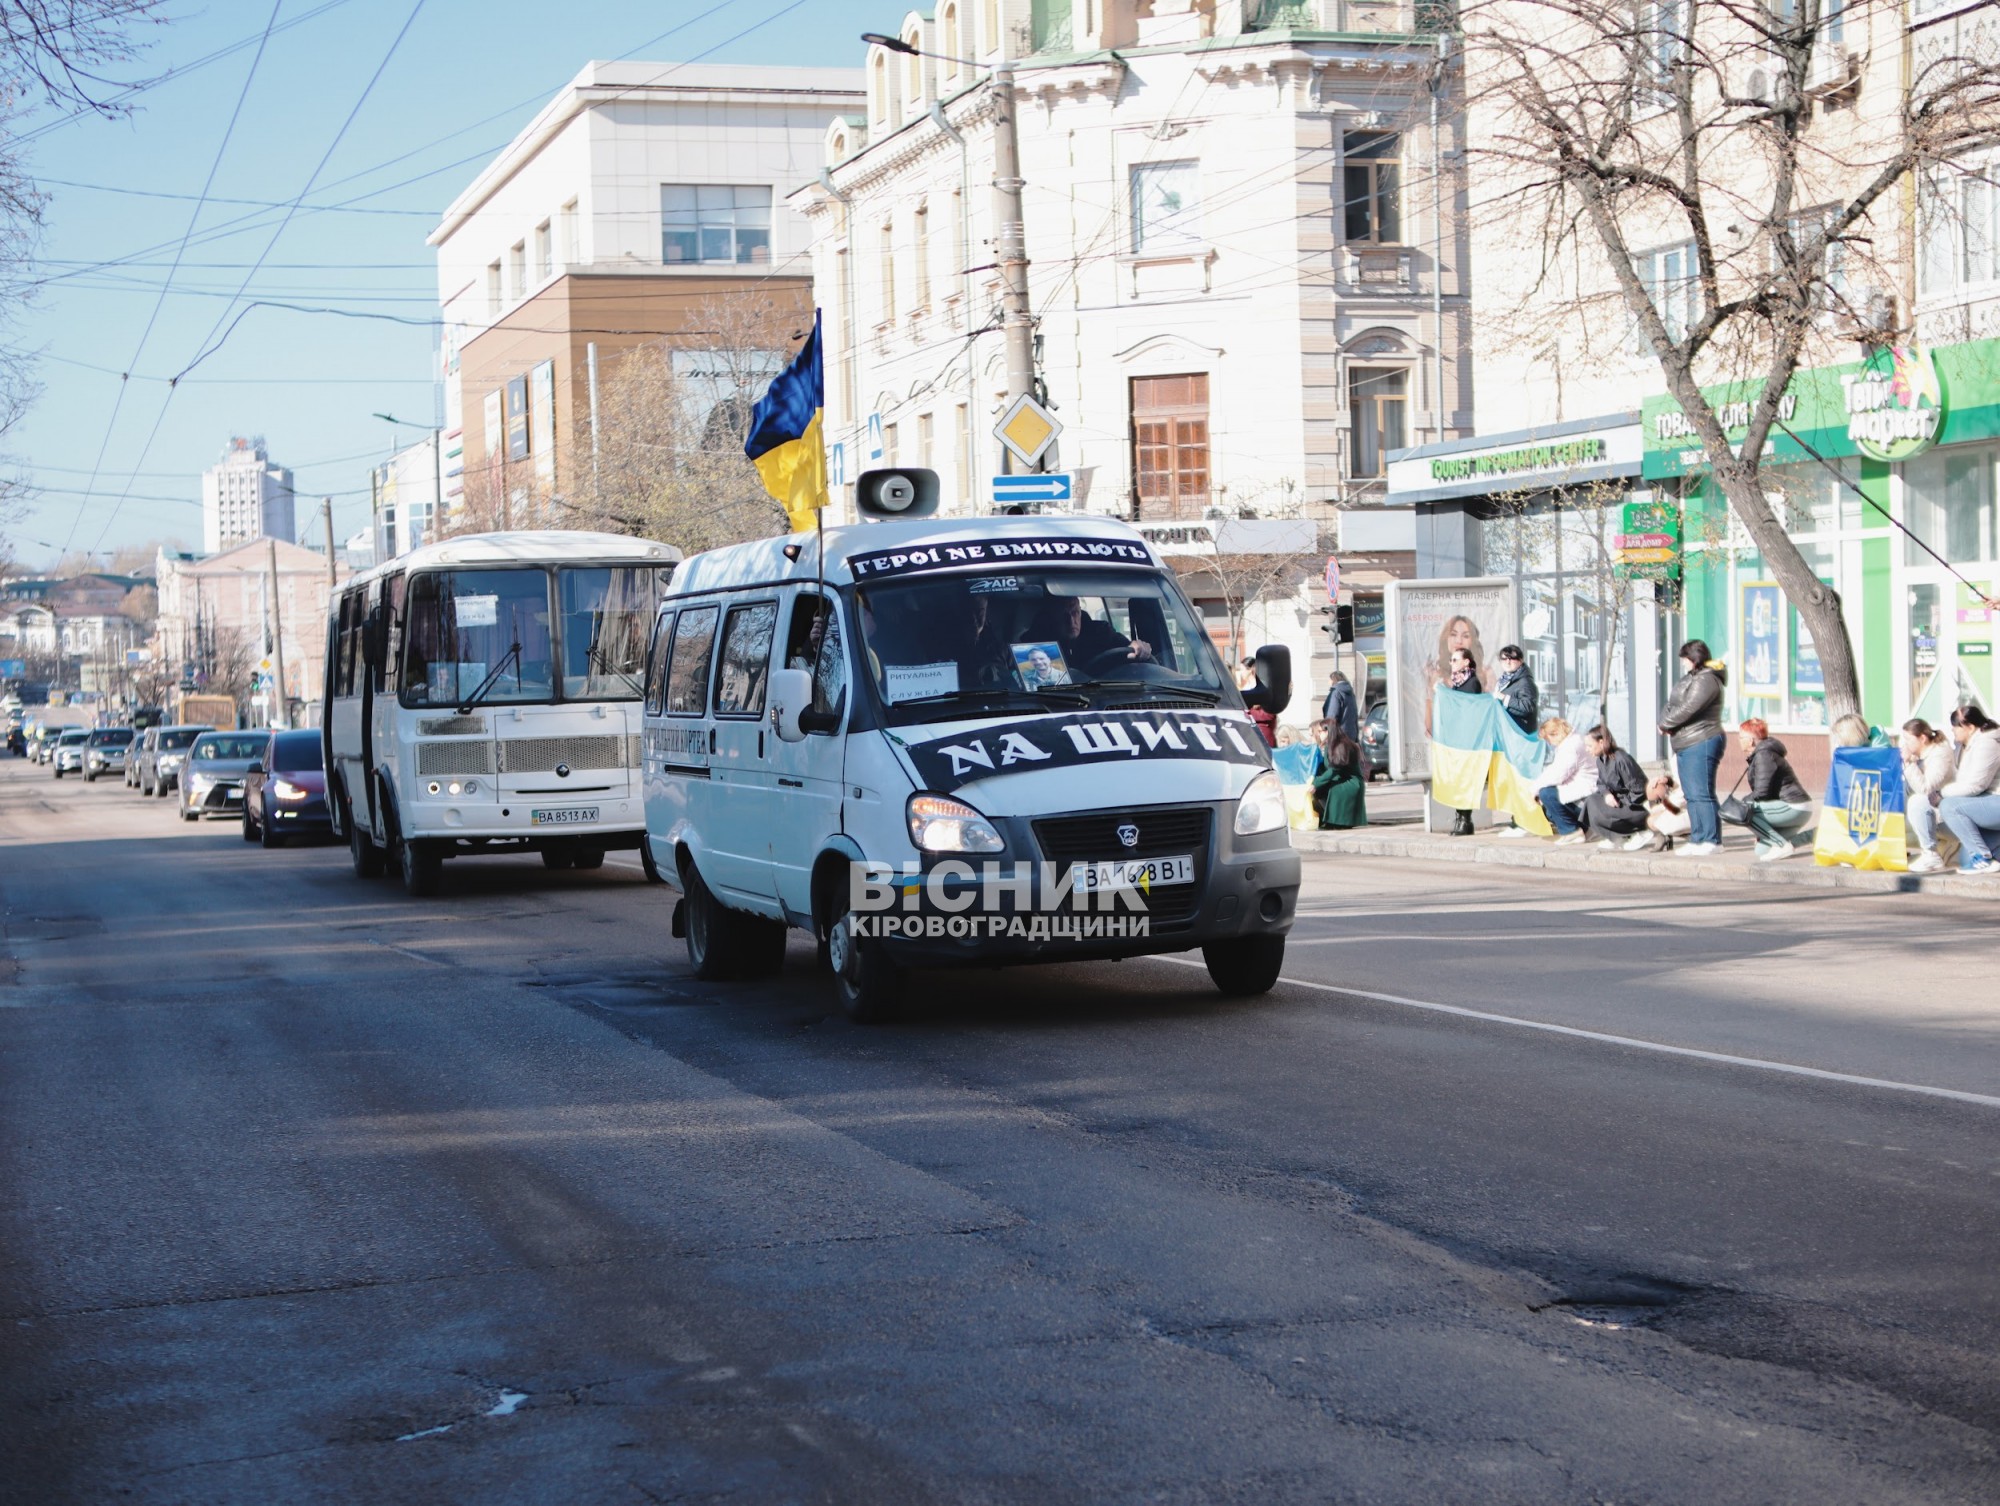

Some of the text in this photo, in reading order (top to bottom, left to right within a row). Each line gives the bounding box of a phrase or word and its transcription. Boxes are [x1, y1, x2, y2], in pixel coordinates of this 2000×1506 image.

[1429, 439, 1601, 479] TOURIST INFORMATION CENTER
[854, 548, 941, 574] ГЕРОЇ
[990, 541, 1149, 560] ВМИРАЮТЬ
[1407, 591, 1500, 601] ЛАЗЕРНА ЕПІЛЯЦІЯ
[890, 671, 942, 680] РИТУАЛЬНА
[890, 689, 940, 699] СЛУЖБА
[1061, 721, 1257, 757] ЩИТІ
[538, 810, 596, 823] BA 8513 AX
[1085, 860, 1183, 888] BA 1628 BI
